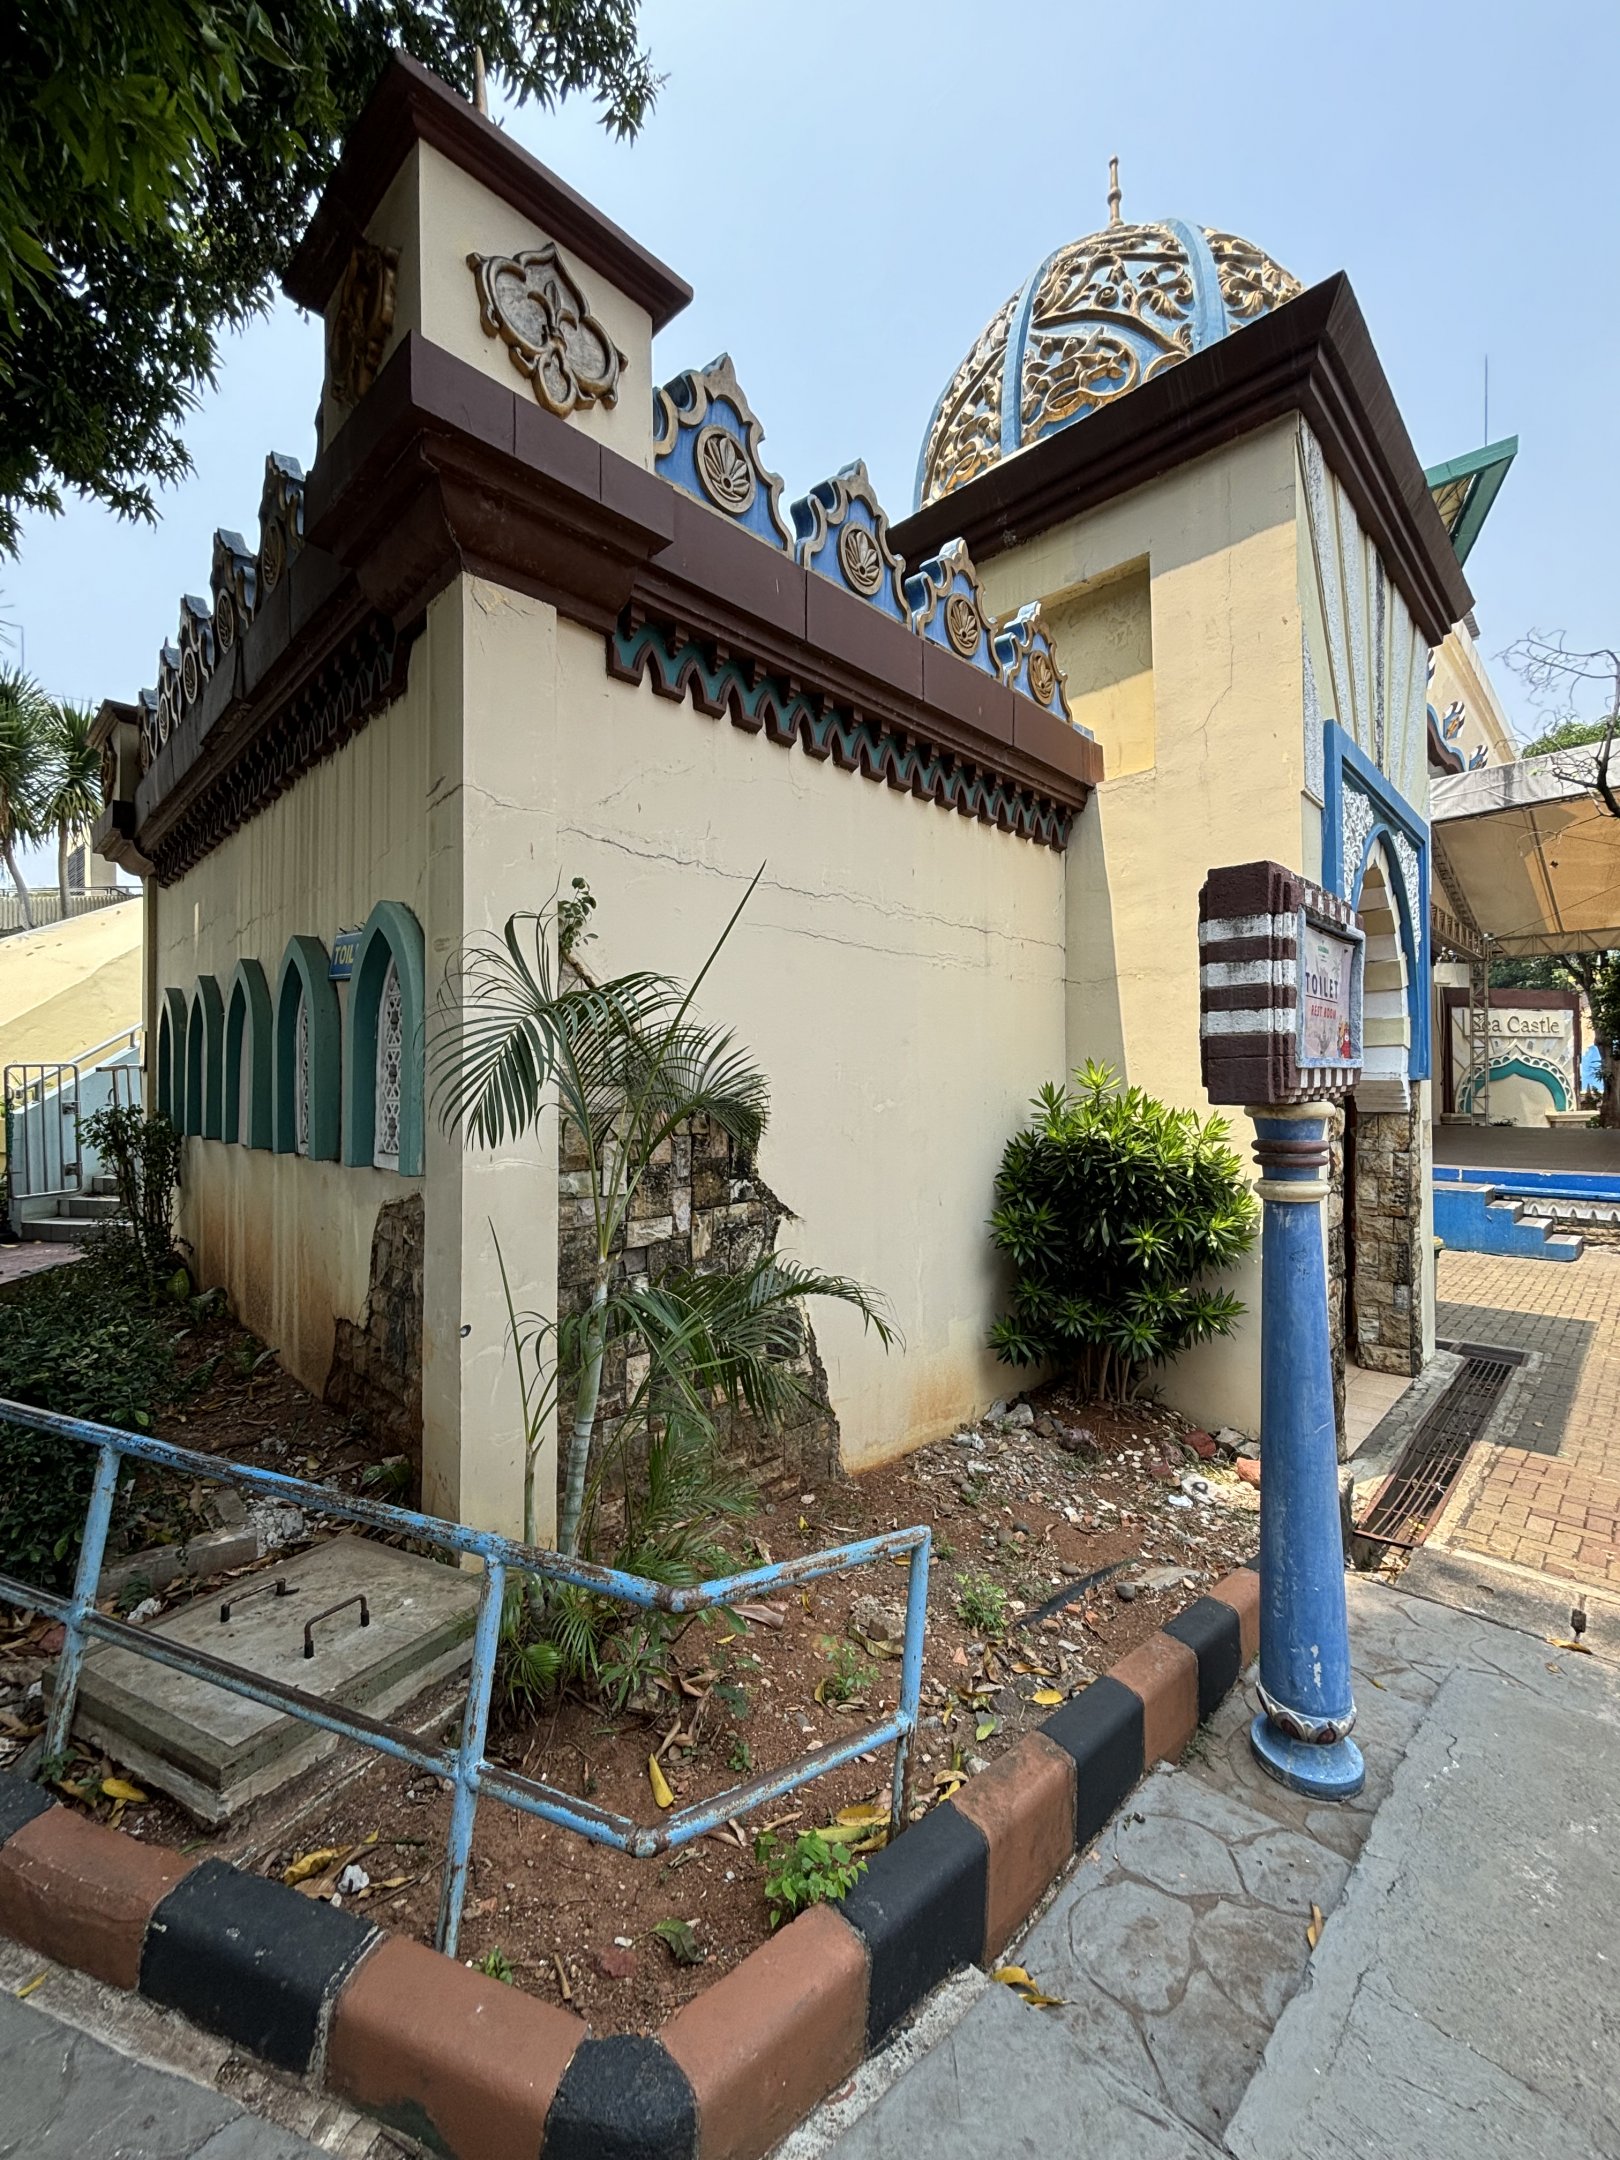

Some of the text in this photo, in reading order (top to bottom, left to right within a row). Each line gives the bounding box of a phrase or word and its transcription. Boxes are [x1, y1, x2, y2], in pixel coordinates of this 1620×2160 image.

[334, 944, 359, 965] TOIL
[1305, 972, 1338, 999] TOILET
[1311, 1004, 1322, 1016] REST
[1507, 1015, 1560, 1033] Castle
